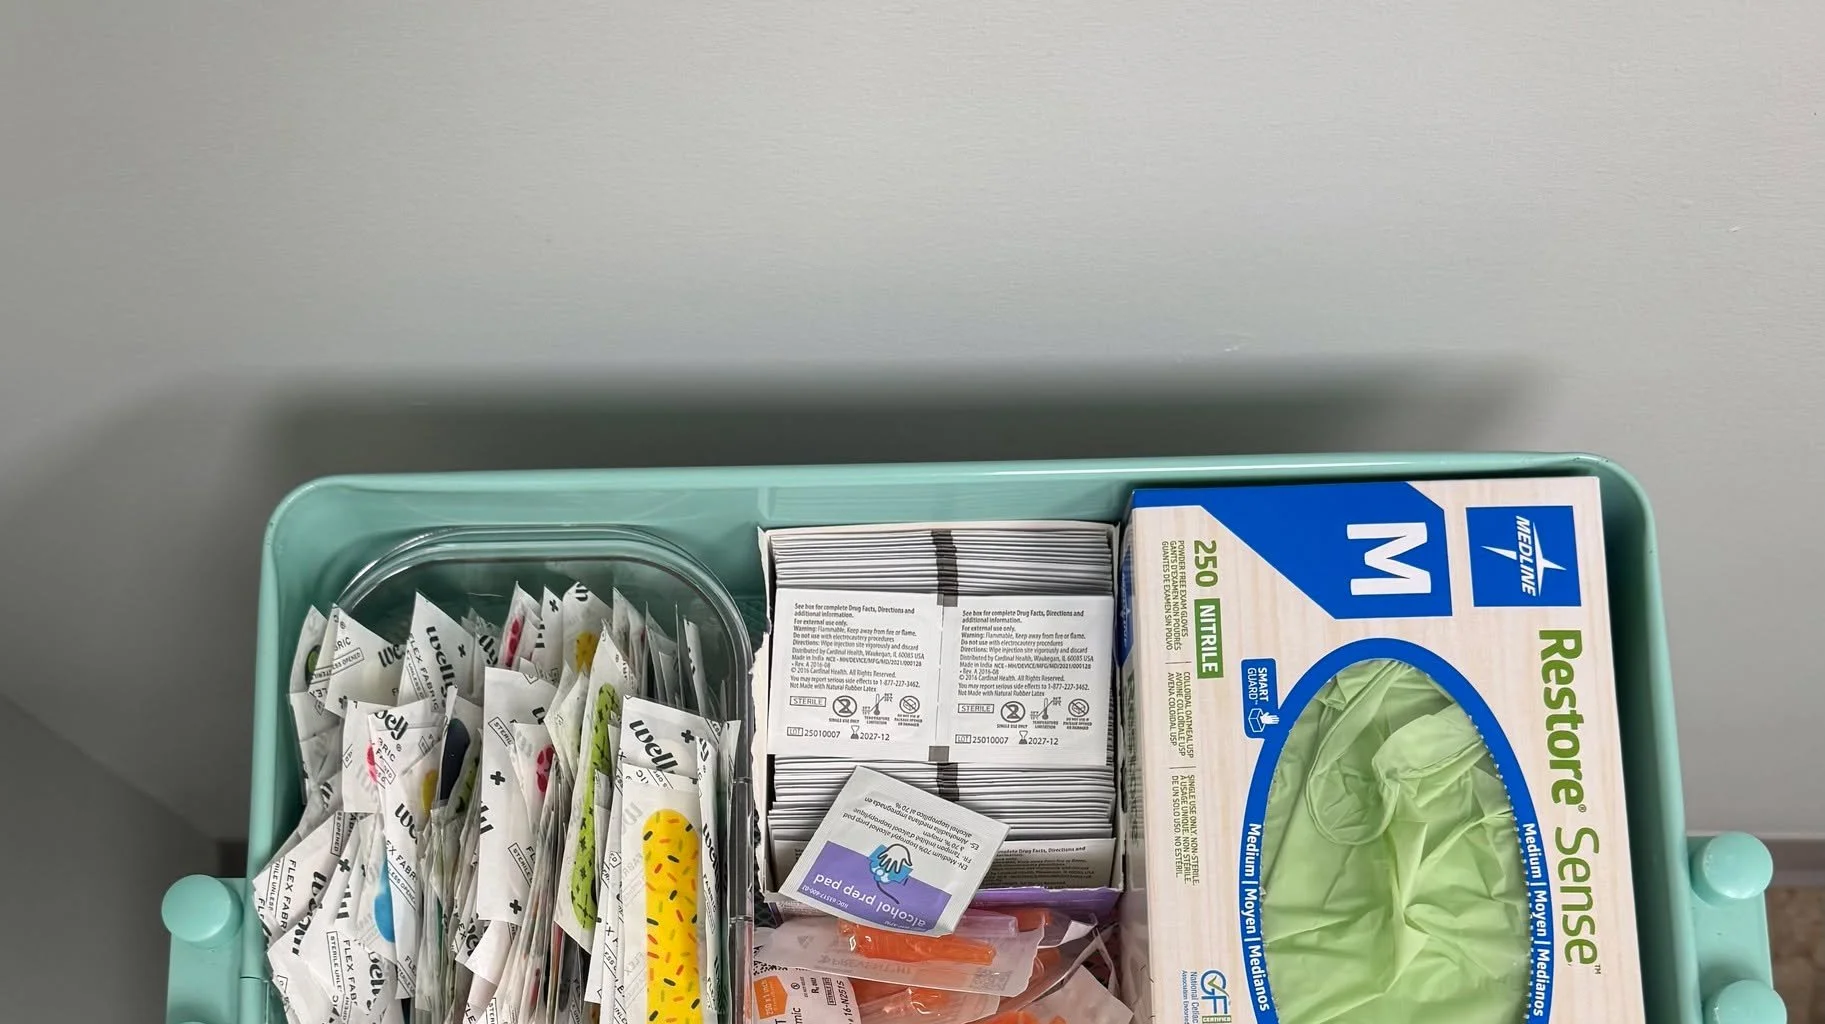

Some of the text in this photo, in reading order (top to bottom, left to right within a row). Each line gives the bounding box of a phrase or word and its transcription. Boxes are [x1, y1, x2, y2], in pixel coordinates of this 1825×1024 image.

[1162, 541, 1170, 573] GUANTES
[1178, 540, 1186, 570] POWDER
[1346, 522, 1431, 596] M
[1515, 515, 1536, 597] MEDLINE
[1163, 574, 1170, 583] DE
[1170, 564, 1179, 601] D'EXAMEN
[823, 604, 848, 612] complete
[848, 605, 861, 613] Drug
[877, 606, 904, 614] Directions
[1017, 610, 1030, 618] Drug
[1172, 602, 1180, 616] NON
[1194, 540, 1219, 673] 250 NITRILE
[1173, 617, 1182, 650] POUDRÉS
[341, 651, 361, 665] OPENED
[420, 667, 440, 711] FABRIC
[1258, 667, 1269, 702] SMART
[793, 698, 823, 706] STERILE
[804, 729, 841, 739] 25010007
[860, 732, 890, 741] 2027-12
[957, 735, 970, 743] LOT
[1185, 711, 1193, 742] OATMEAL
[629, 719, 679, 773] well
[1028, 737, 1058, 745] 2027-12
[1172, 775, 1179, 785] DE
[1172, 786, 1179, 796] UN
[1180, 782, 1188, 804] USAGE
[852, 806, 961, 858] Tampon isopropylique
[872, 798, 968, 845] Almohadilla mediana impregnada
[949, 824, 972, 839] alcohol
[868, 822, 957, 865] Medium Isopropyl alcohol
[922, 829, 944, 843] moyen
[1175, 836, 1181, 847] NO
[284, 859, 296, 890] FLEX
[814, 874, 840, 890] pad
[844, 887, 876, 906] prep
[876, 902, 926, 927] alcohol
[1241, 823, 1270, 1011] Medium Moyen Medianos
[1523, 823, 1550, 1017] Medium Moyen Medianos
[329, 936, 340, 971] STERILE
[343, 939, 354, 972] FLEX
[836, 980, 853, 1016] 16-N251S
[1190, 972, 1198, 999] National
